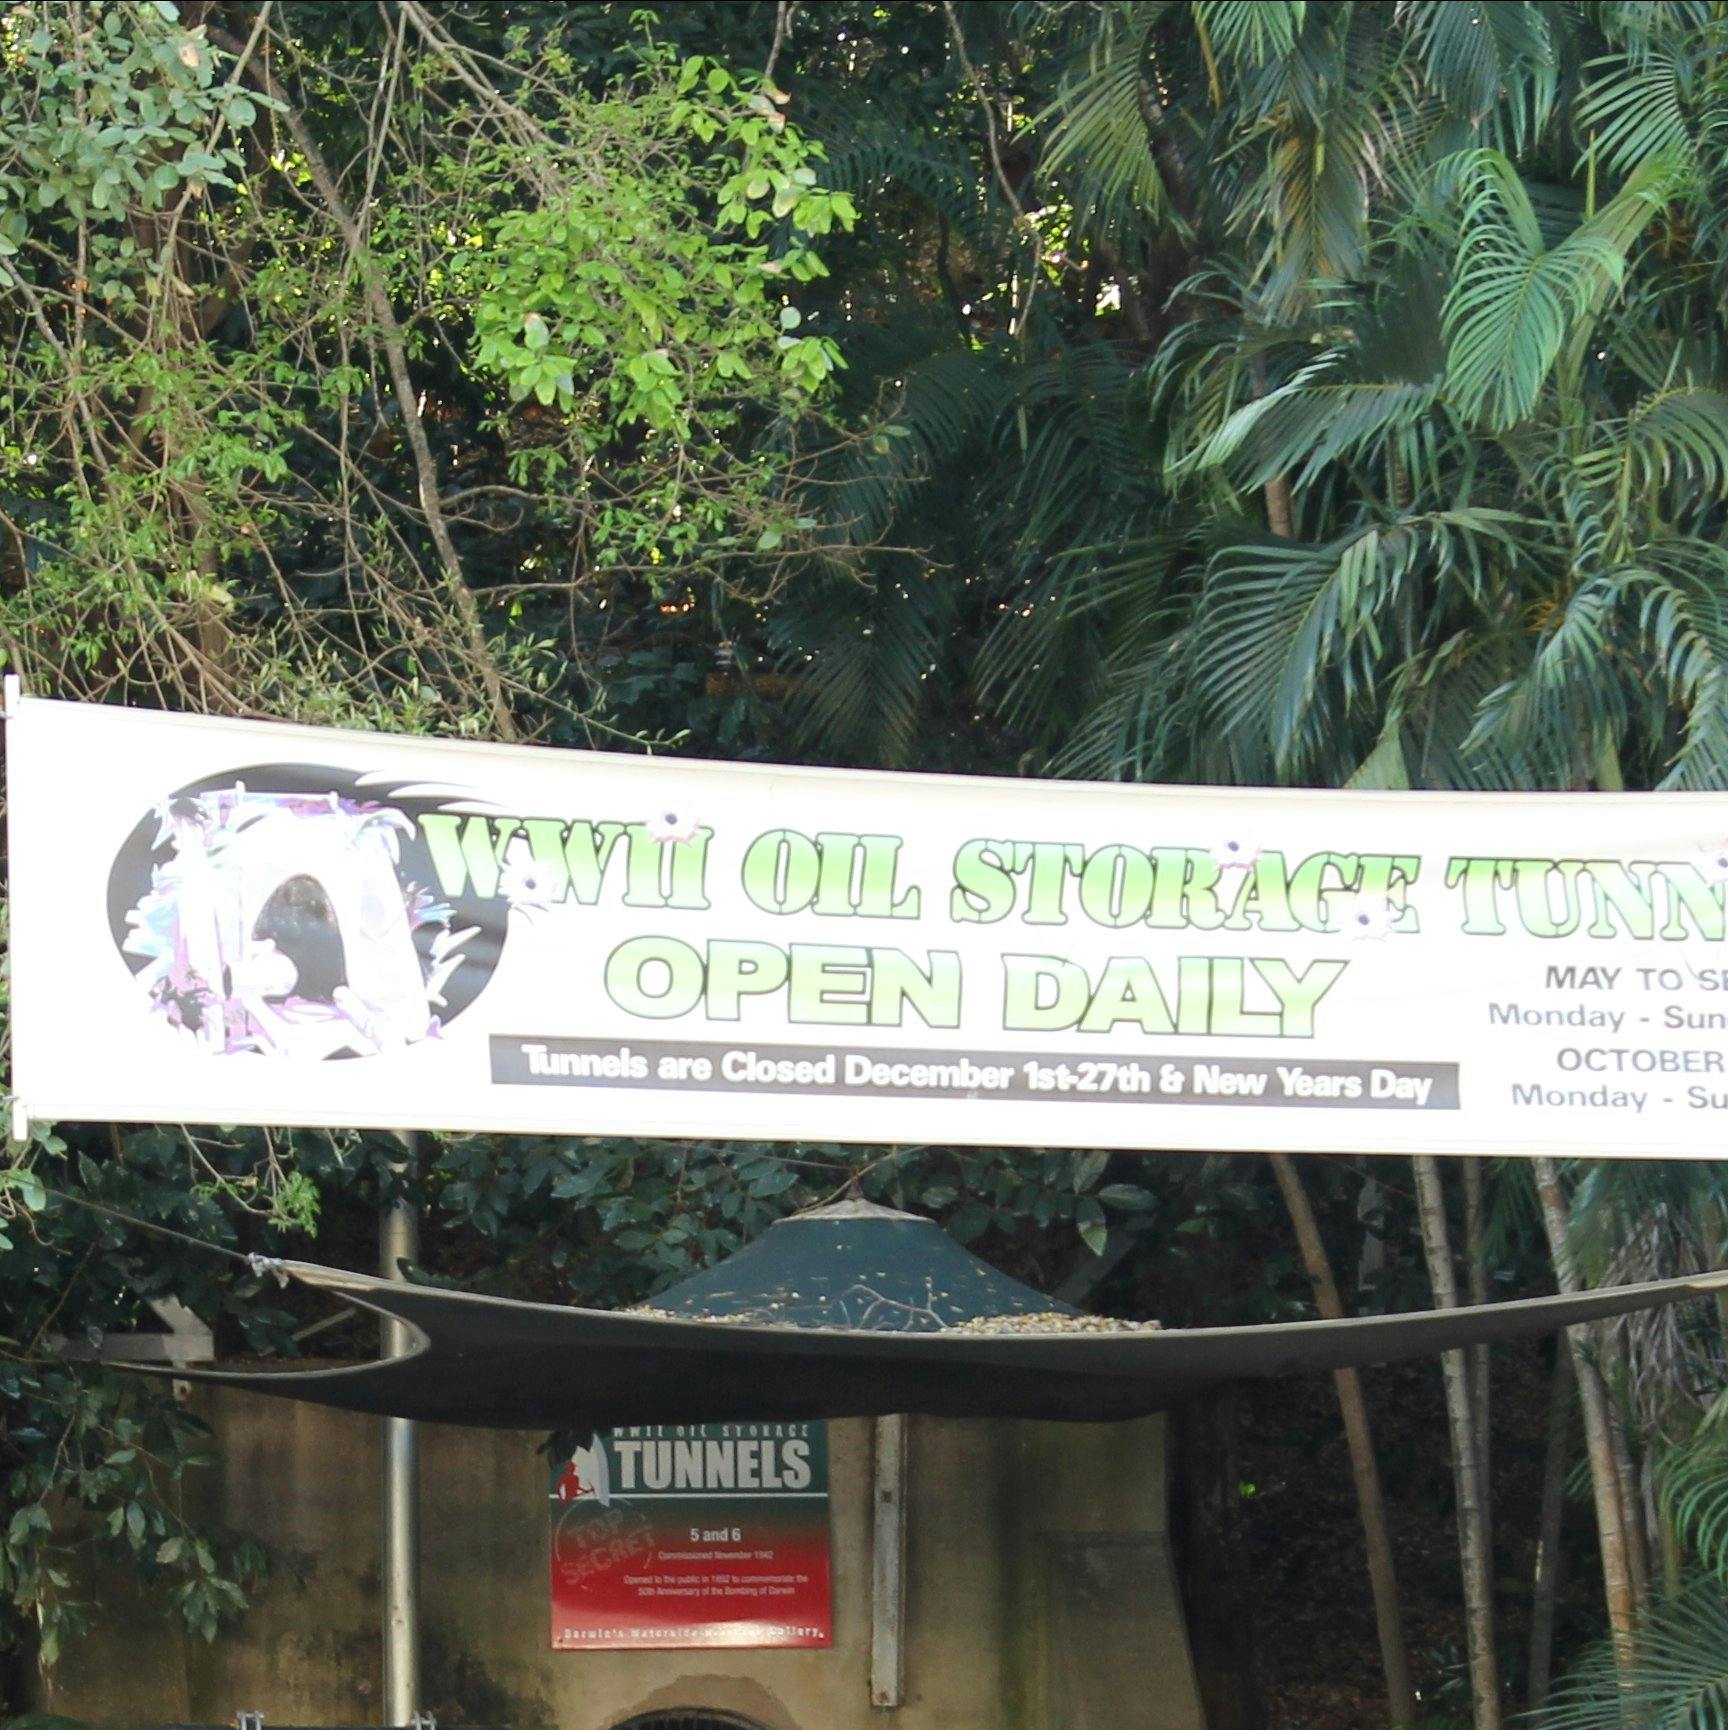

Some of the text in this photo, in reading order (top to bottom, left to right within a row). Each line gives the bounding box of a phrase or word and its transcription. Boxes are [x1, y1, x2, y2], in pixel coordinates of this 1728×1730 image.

[417, 813, 715, 910] WWII
[741, 828, 921, 920] OIL
[950, 838, 1422, 933] STORAGE
[604, 935, 1350, 1038] OPEN DAILY
[1545, 966, 1621, 990] MAY
[1637, 968, 1683, 991] TO
[1488, 1003, 1625, 1031] Monday
[522, 1044, 1433, 1105] Tunnels are Closed December 1st-27th & New Years Day
[1557, 1048, 1725, 1073] OCTOBER
[1511, 1084, 1647, 1114] Monday
[613, 1424, 809, 1437] WWII OIL STORAGE
[614, 1441, 812, 1489] TUNNELS
[690, 1528, 741, 1542] 5 and 6
